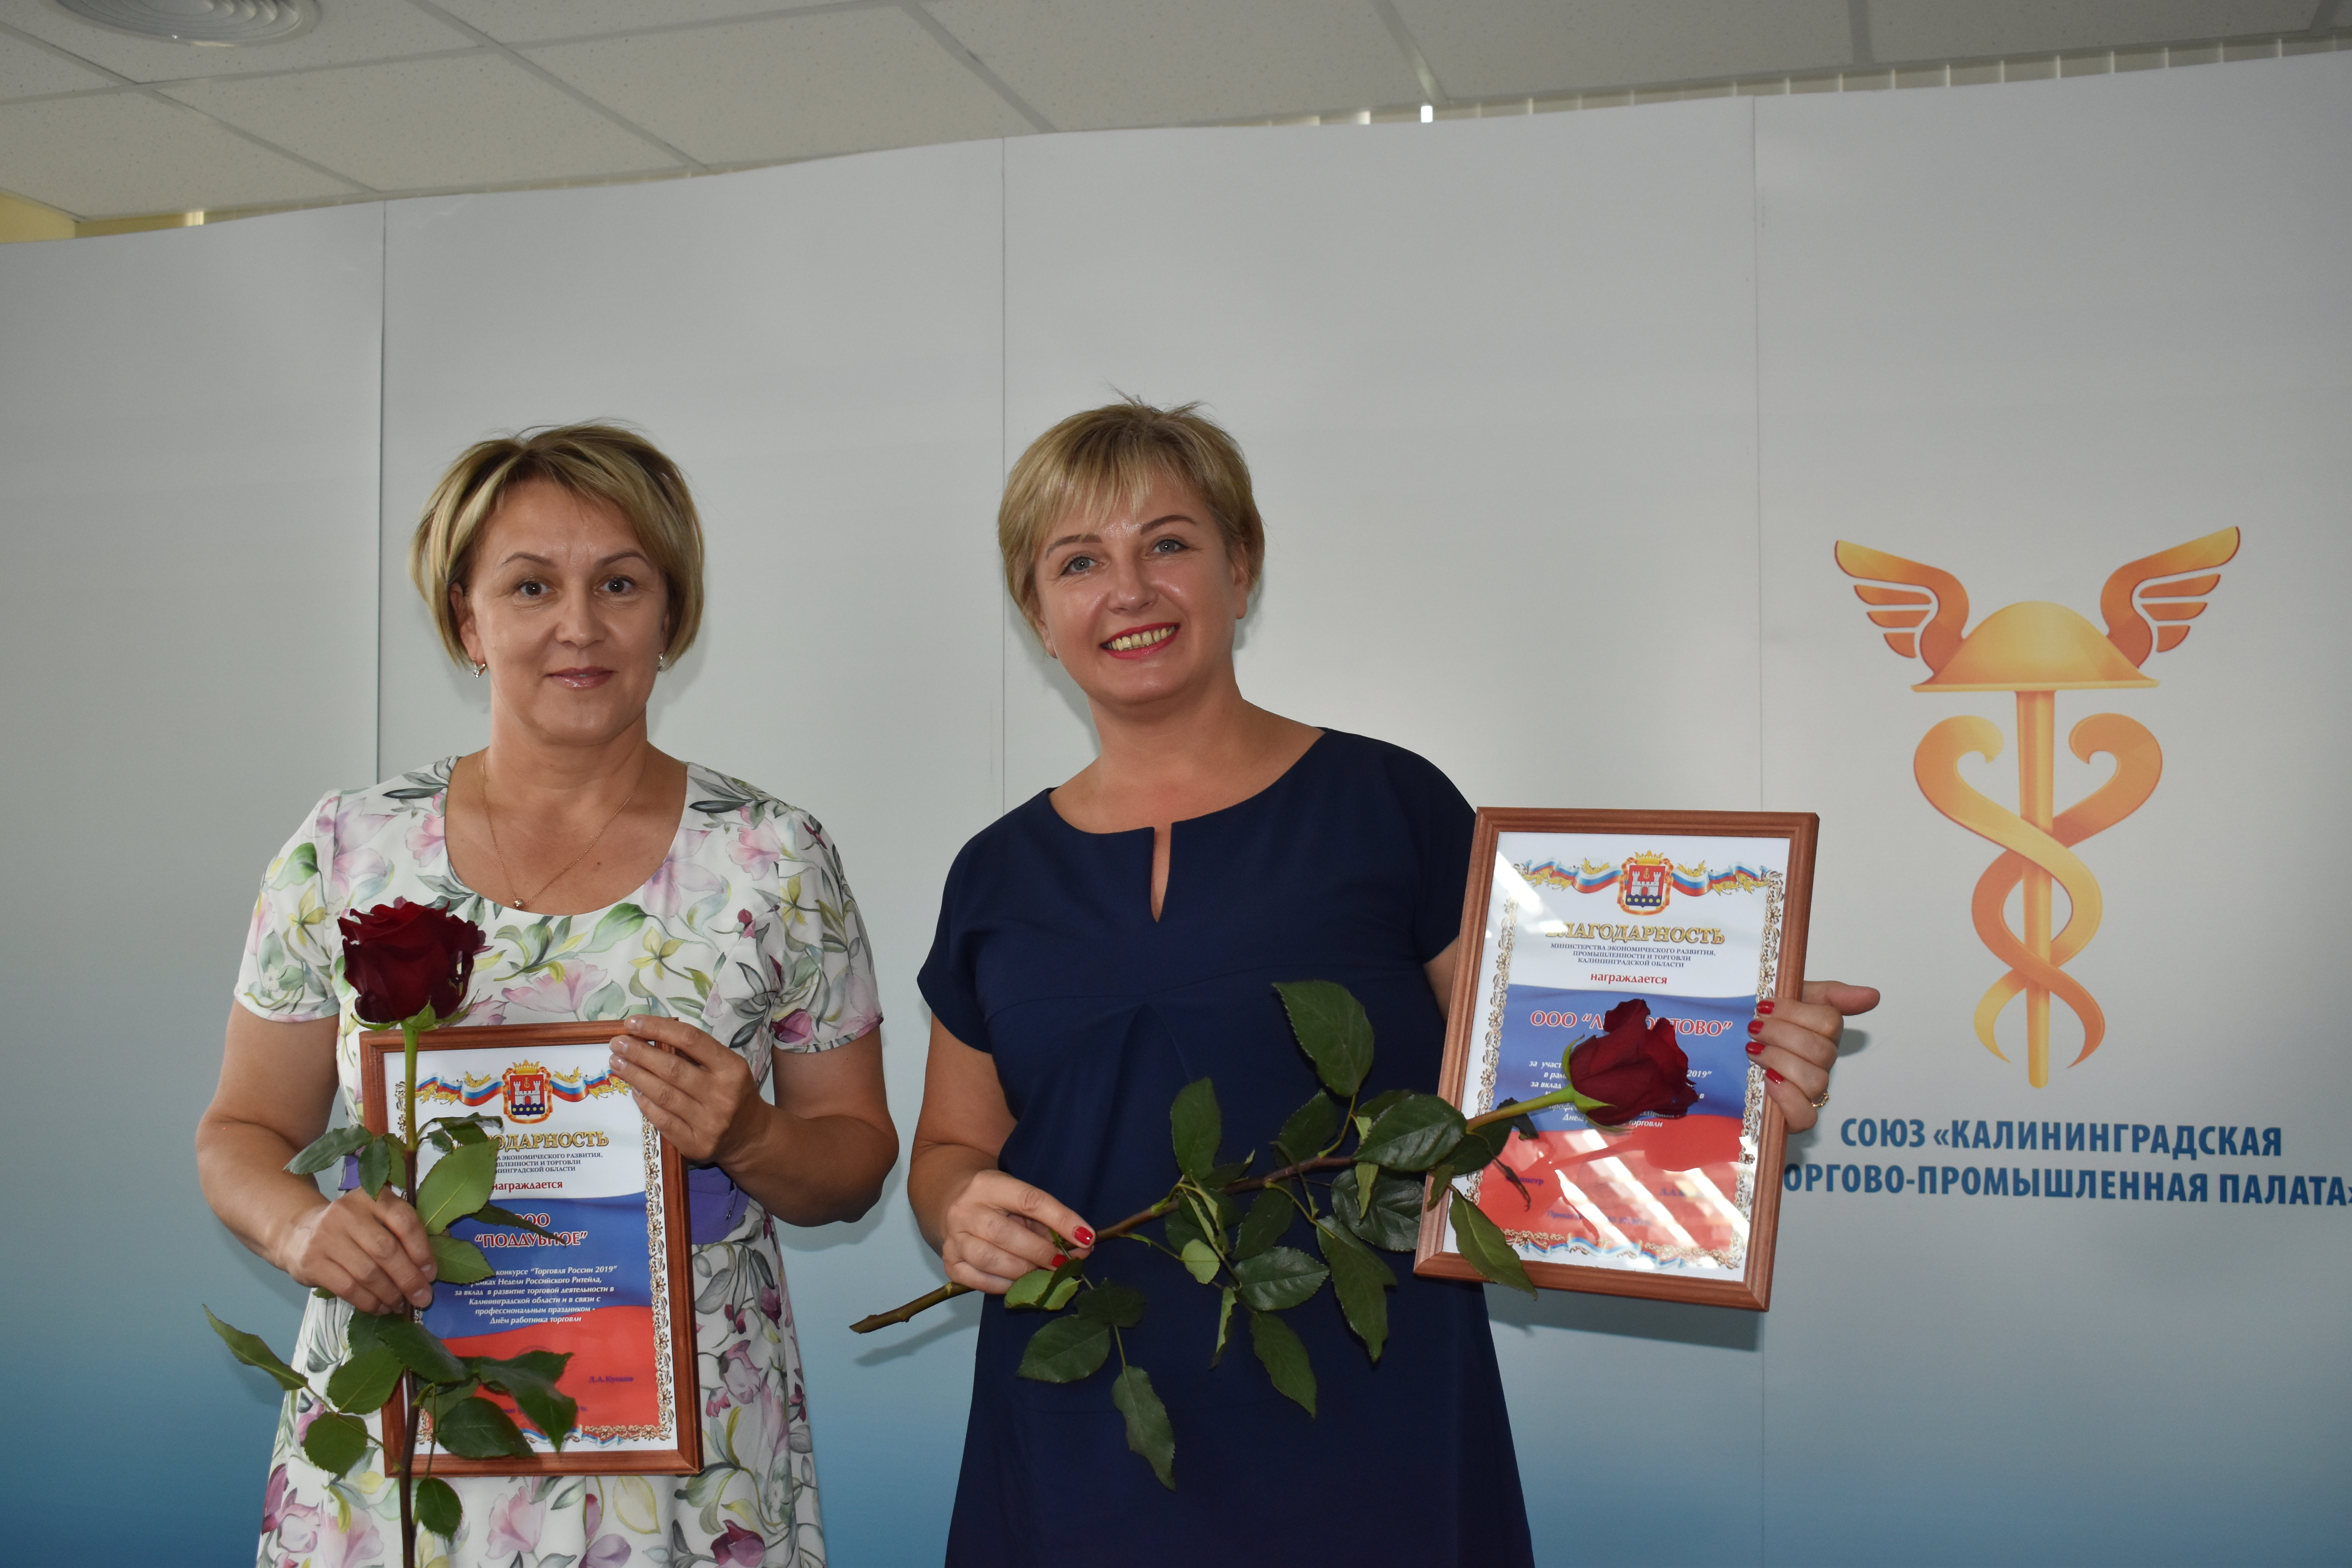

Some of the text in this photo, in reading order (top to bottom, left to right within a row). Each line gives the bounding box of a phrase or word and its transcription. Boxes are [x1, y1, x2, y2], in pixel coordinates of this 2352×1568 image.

[1546, 922, 1726, 944] ЛАГОДАРНОСТЬ
[1573, 951, 1646, 959] ПРОМЫШЛЕННОСТИ
[1577, 957, 1650, 966] КАЛИНИНГРАДСКОЙ
[1590, 973, 1668, 984] награждается
[1530, 1010, 1577, 1027] ООО
[1840, 1118, 2281, 1161] СОЮЗ «КАЛИНИНГРАДСКАЯ
[492, 1181, 563, 1192] награждается
[1783, 1163, 2208, 1202] ОРГОВО-ПРОМЫШЛЕННАЯ
[531, 1267, 566, 1276] “Торговля
[493, 1289, 526, 1297] развитие
[527, 1287, 559, 1296] торговой
[469, 1298, 530, 1306] Калининградской
[475, 1307, 546, 1316] профессиональным
[511, 1316, 548, 1325] работника
